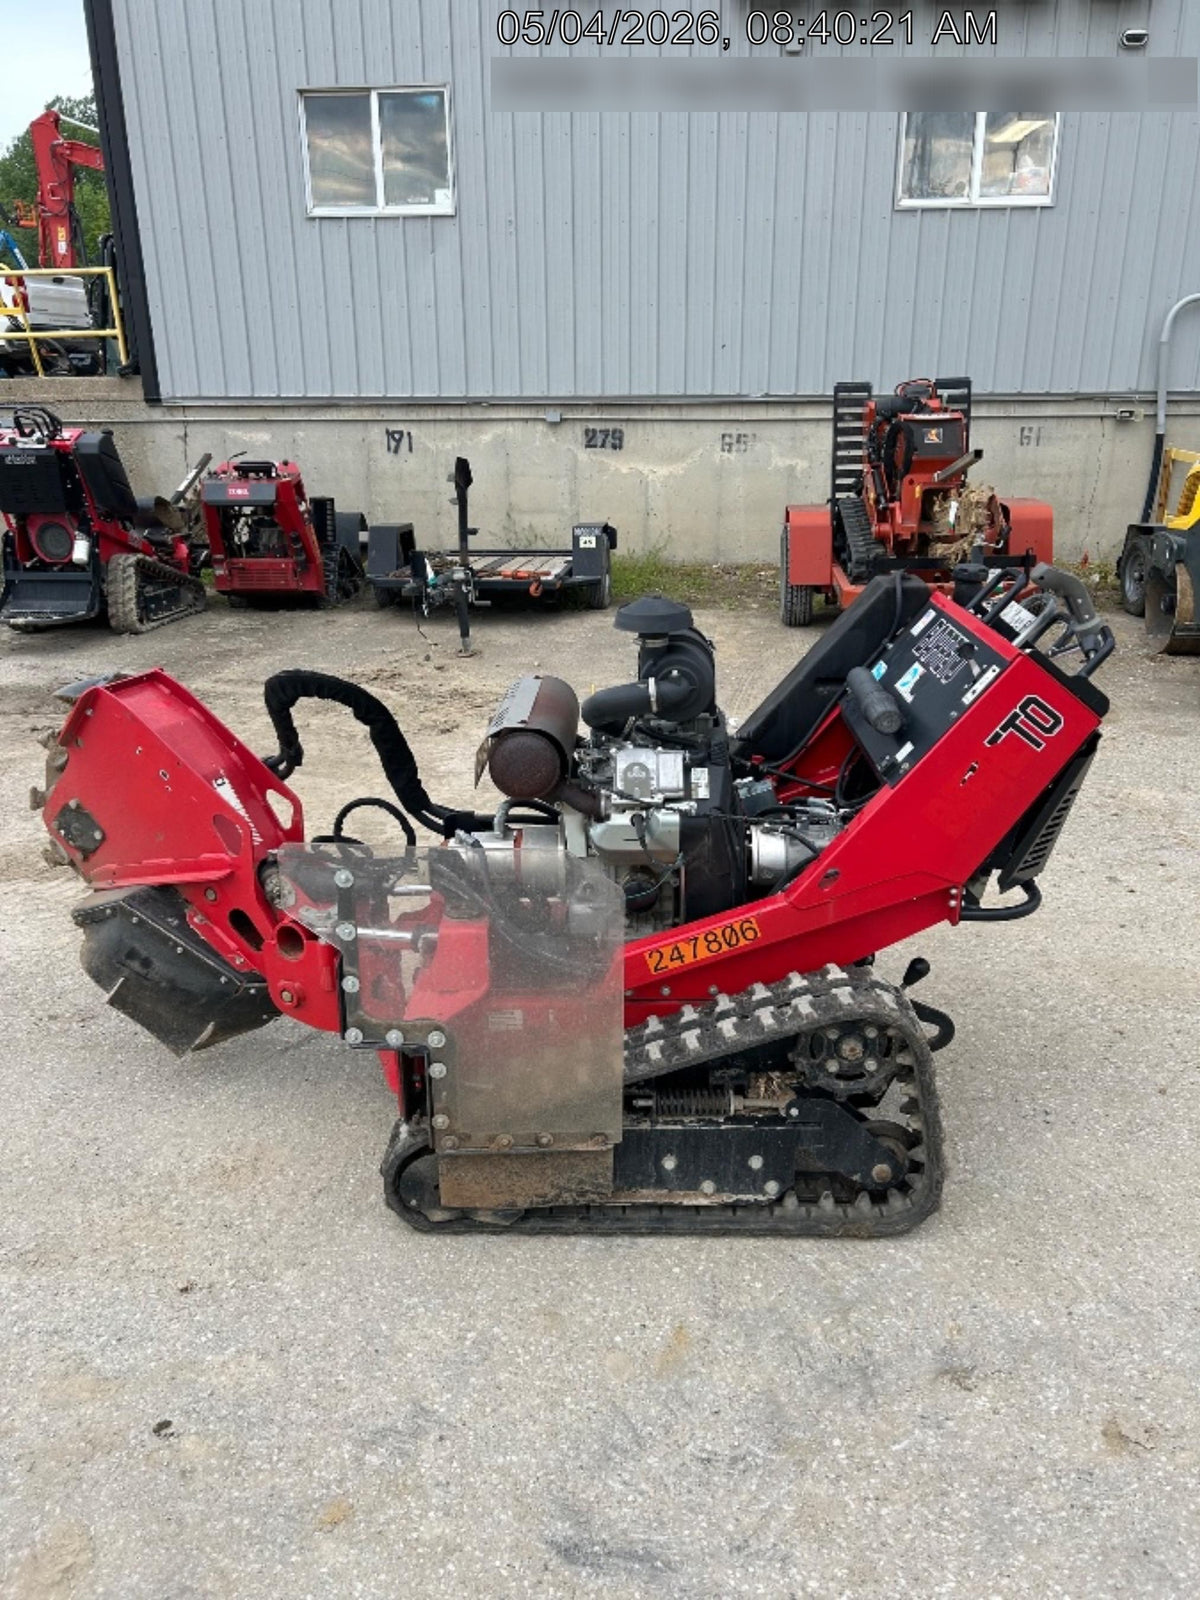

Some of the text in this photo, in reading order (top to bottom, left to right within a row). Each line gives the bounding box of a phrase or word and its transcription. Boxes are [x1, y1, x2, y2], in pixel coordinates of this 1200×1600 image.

[386, 428, 413, 454] 191
[584, 428, 625, 450] 279
[648, 920, 758, 973] 247806
